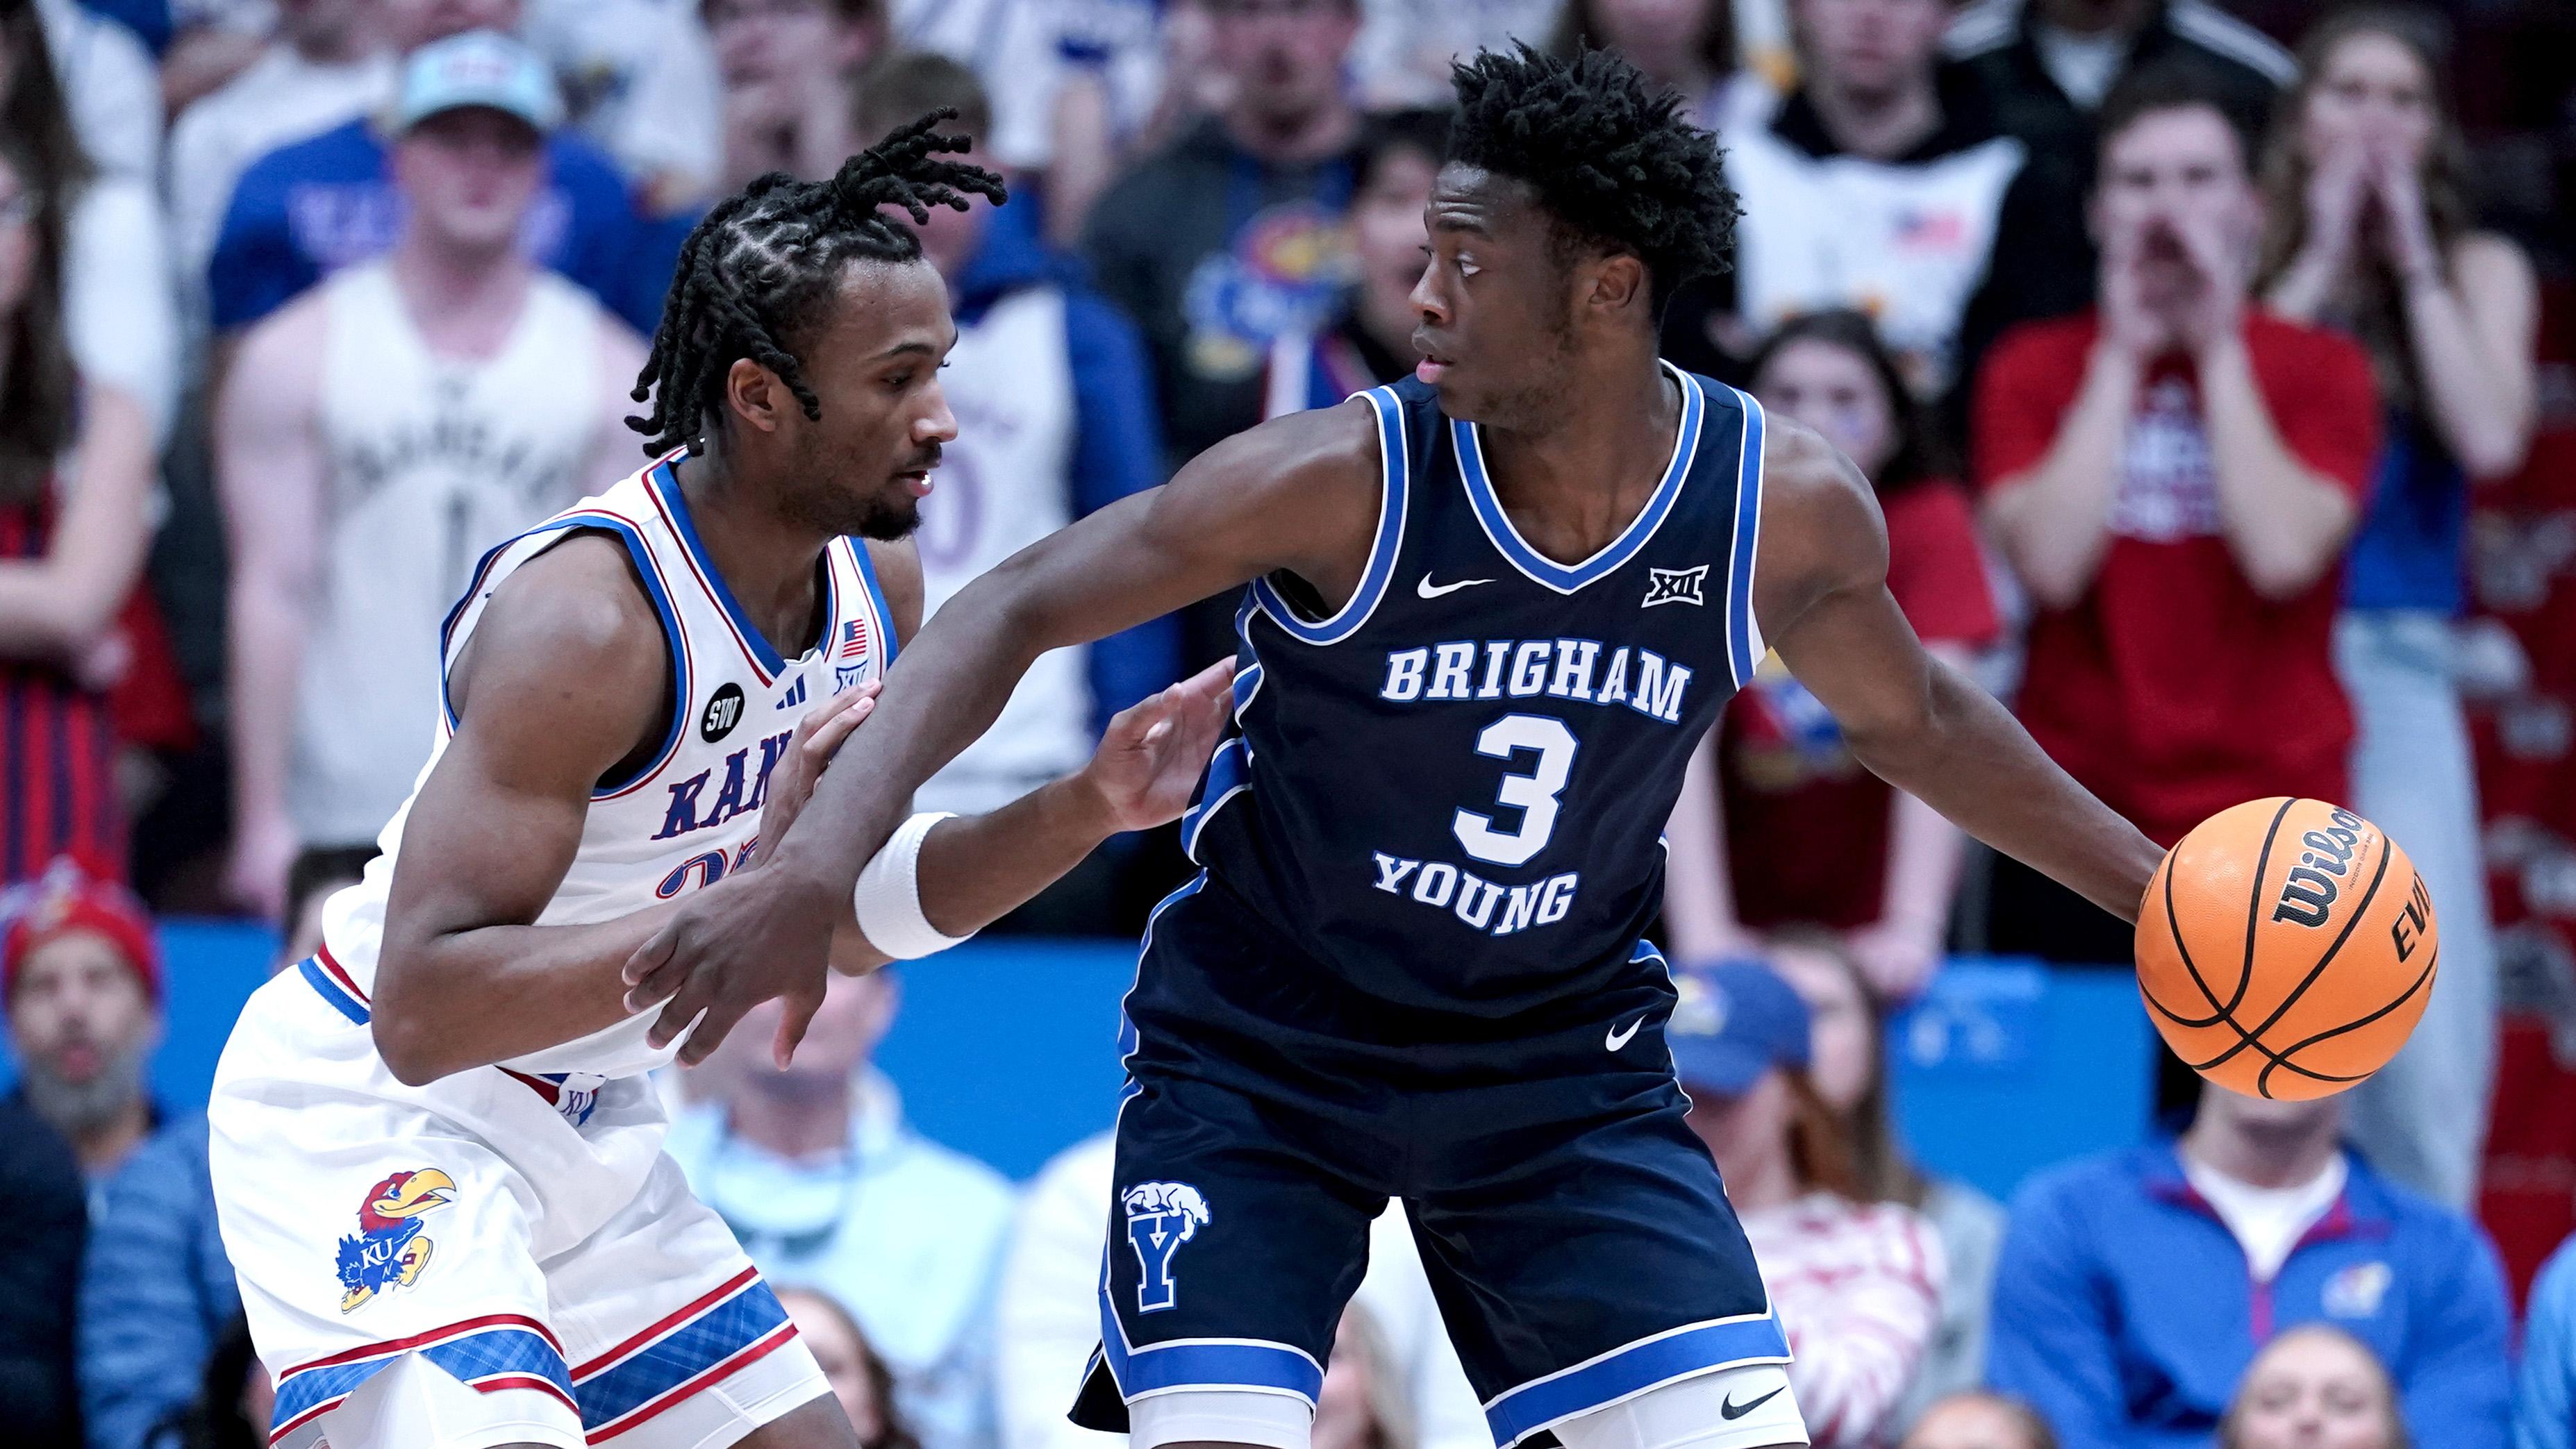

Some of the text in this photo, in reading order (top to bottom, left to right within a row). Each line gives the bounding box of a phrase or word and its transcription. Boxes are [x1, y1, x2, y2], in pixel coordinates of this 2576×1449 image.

[706, 696, 740, 732] SW
[1379, 637, 1694, 725] BRIGHAM
[650, 730, 793, 841] KAN
[1451, 712, 1581, 867] 3
[1372, 850, 1580, 936] YOUNG
[360, 1238, 393, 1270] KU
[1127, 1209, 1185, 1315] Y
